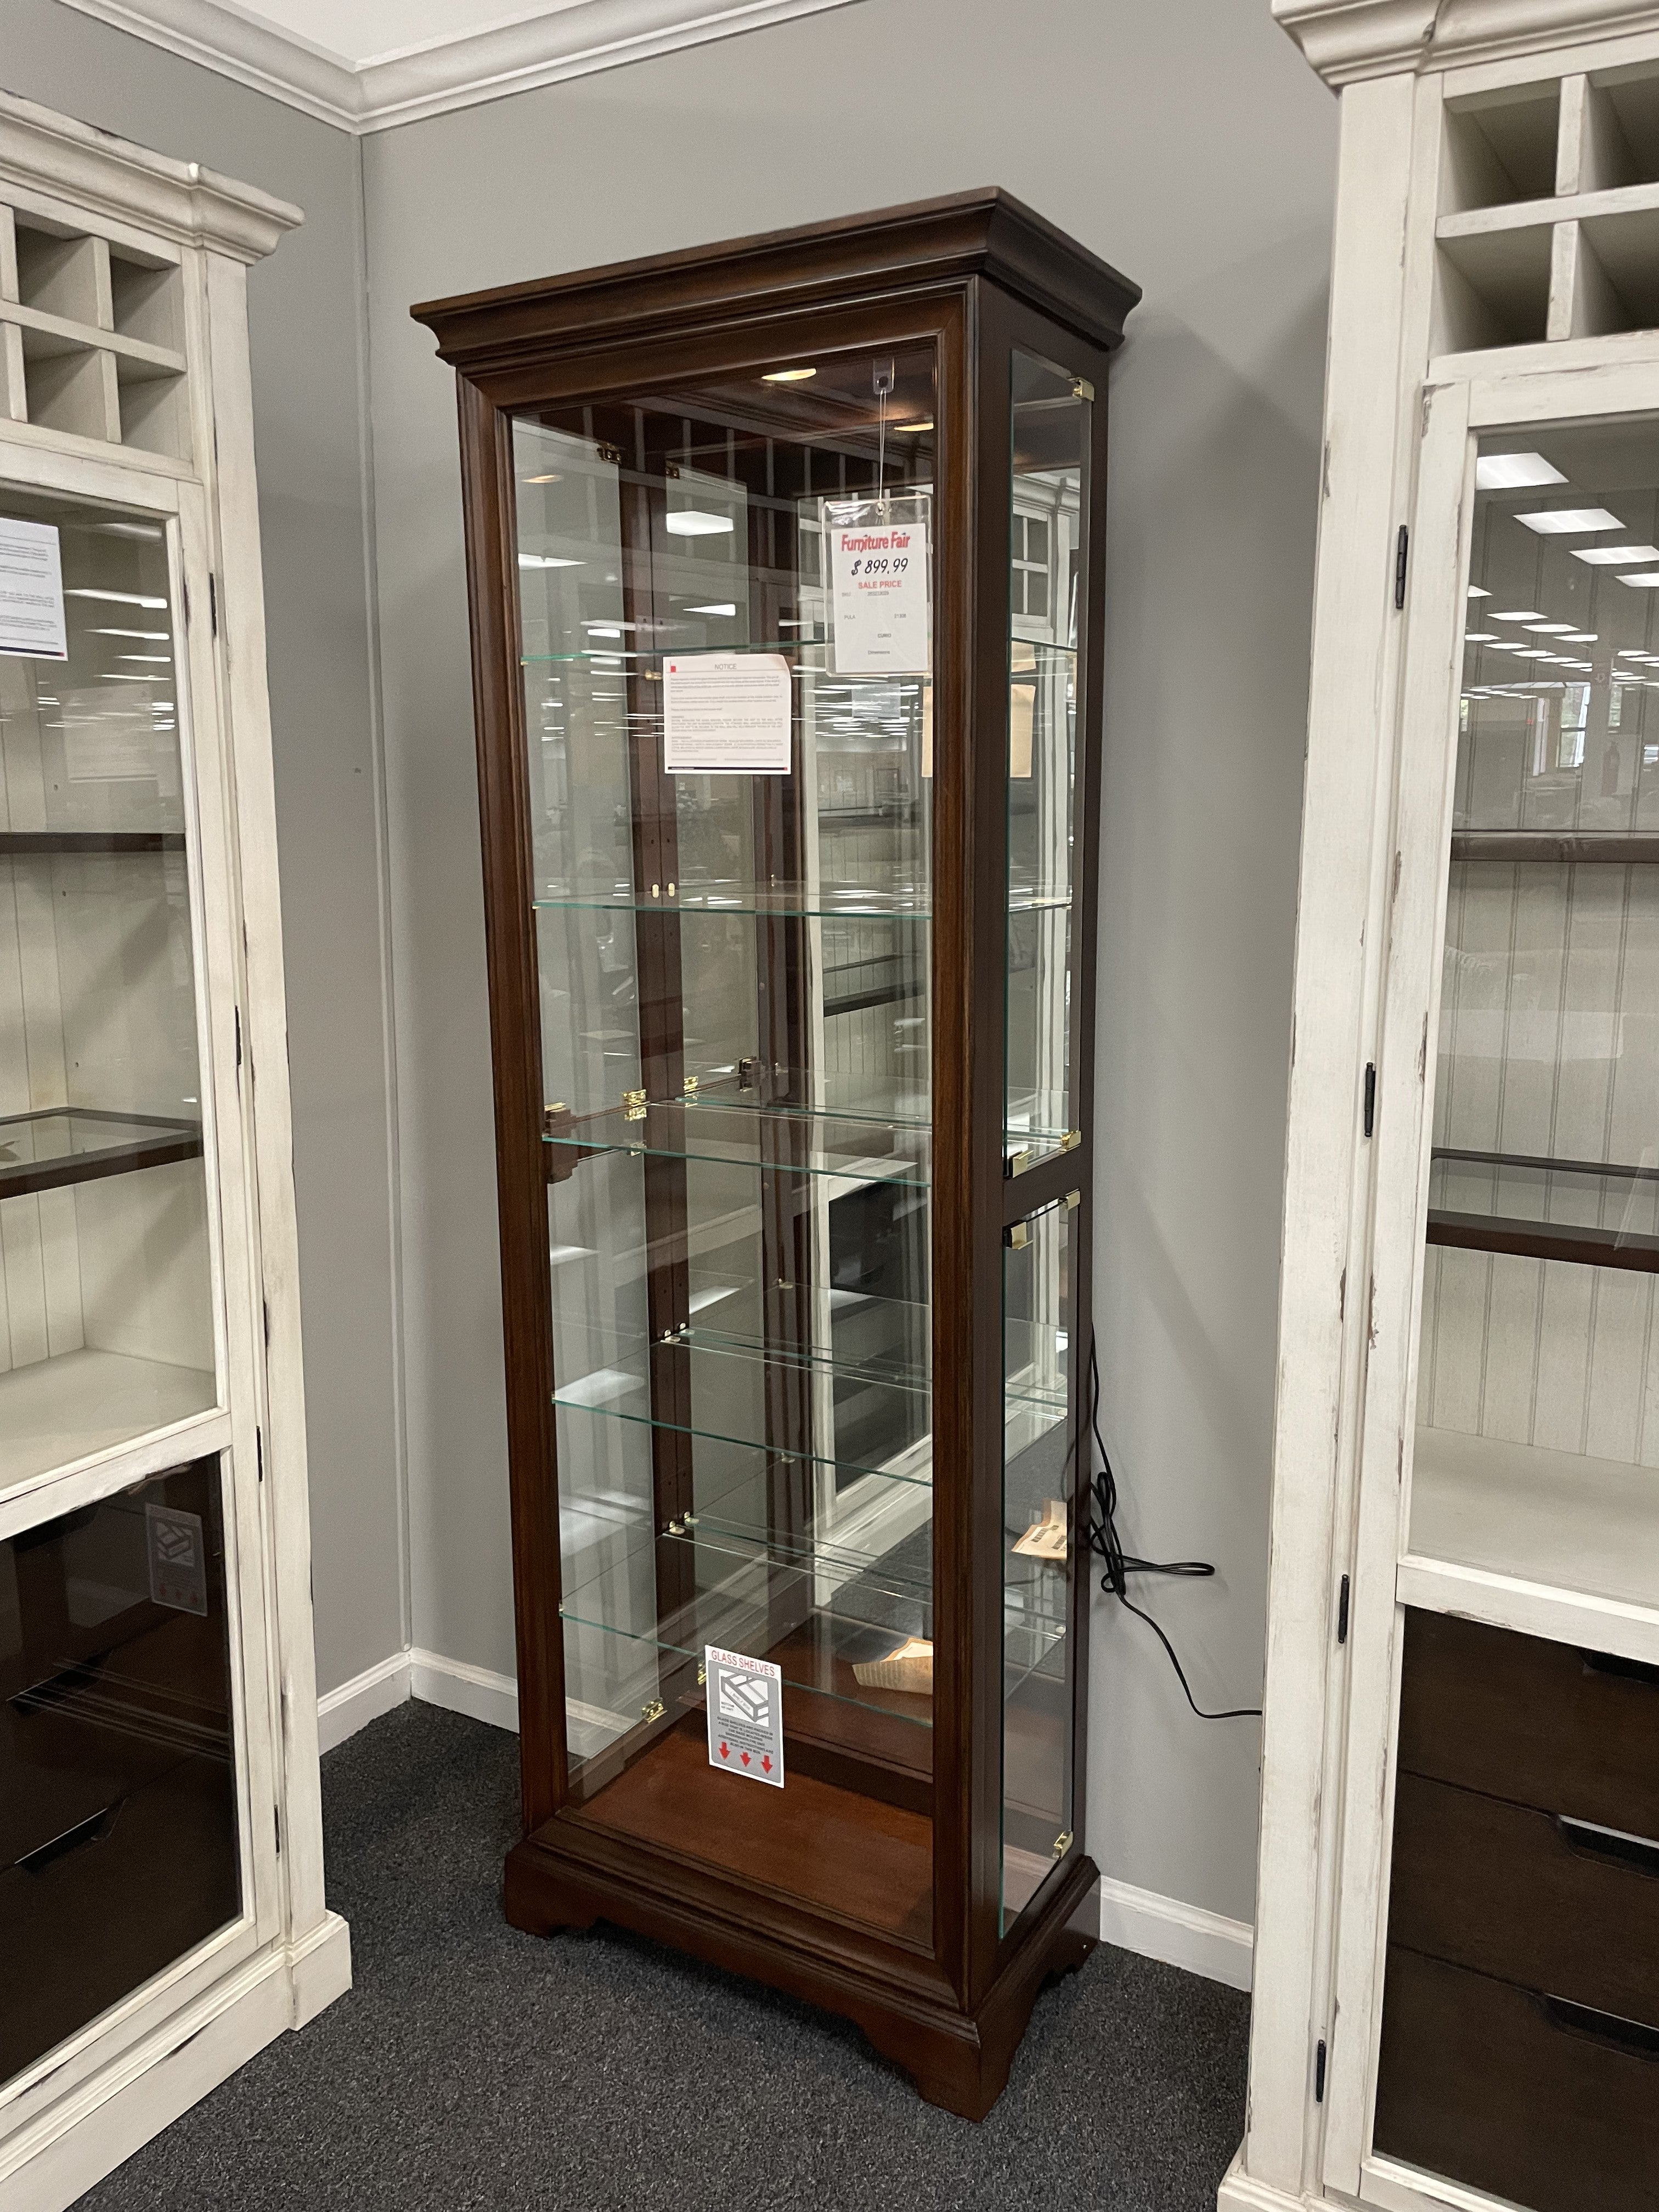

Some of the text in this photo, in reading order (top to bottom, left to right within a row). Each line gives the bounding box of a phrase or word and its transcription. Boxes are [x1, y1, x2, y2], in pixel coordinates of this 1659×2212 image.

[842, 532, 911, 553] Furniture Fair
[851, 558, 908, 575] $ 899.99
[858, 580, 902, 589] SALE PRICE
[712, 1650, 775, 1676] GLASS SHELVES
